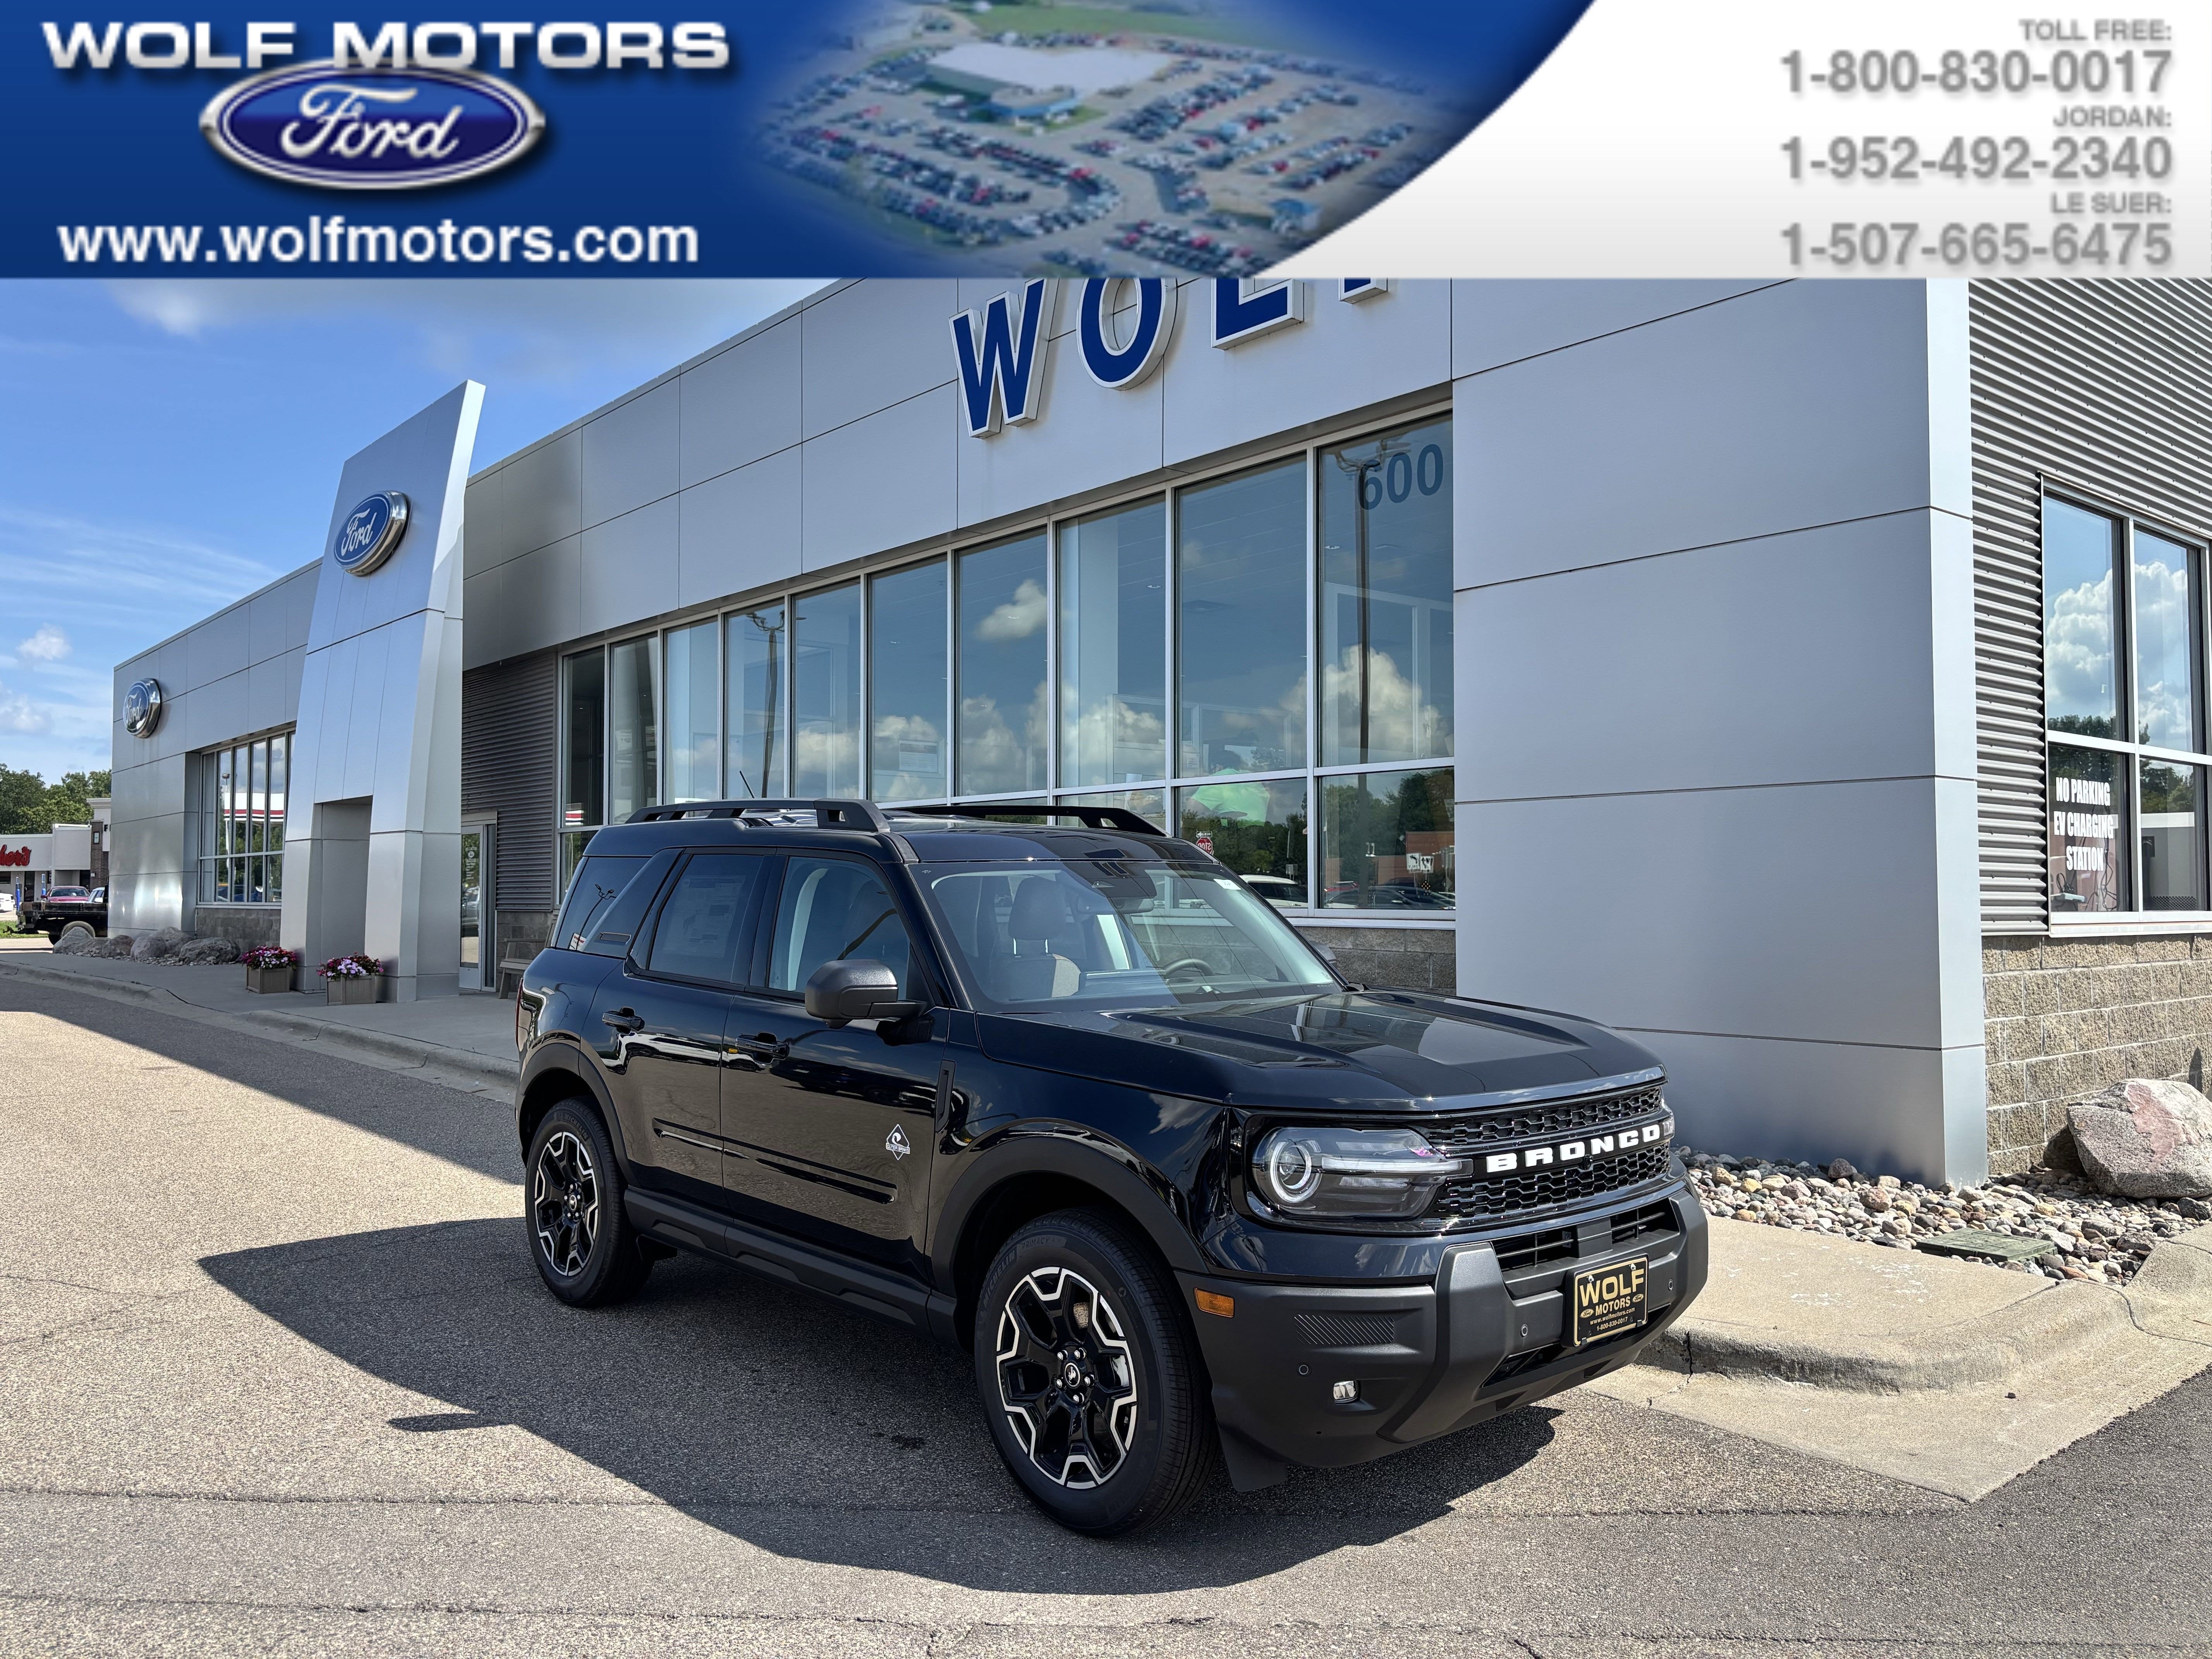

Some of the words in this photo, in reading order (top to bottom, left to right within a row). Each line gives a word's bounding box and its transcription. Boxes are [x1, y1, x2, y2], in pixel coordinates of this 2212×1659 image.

[1358, 444, 1444, 511] 600
[341, 508, 378, 556] Ford
[126, 691, 142, 723] Ford
[2056, 777, 2069, 803] NO
[2071, 778, 2111, 806] PARKING
[2054, 811, 2066, 836] EV
[2067, 812, 2114, 839] CHARGING
[2066, 846, 2104, 871] STATION
[1486, 1125, 1661, 1173] BRONCO
[1022, 1237, 1050, 1249] PRIMACY
[983, 1250, 1016, 1309] MICHELIN
[1580, 1268, 1644, 1307] WOLF
[1595, 1296, 1631, 1316] MOTORS
